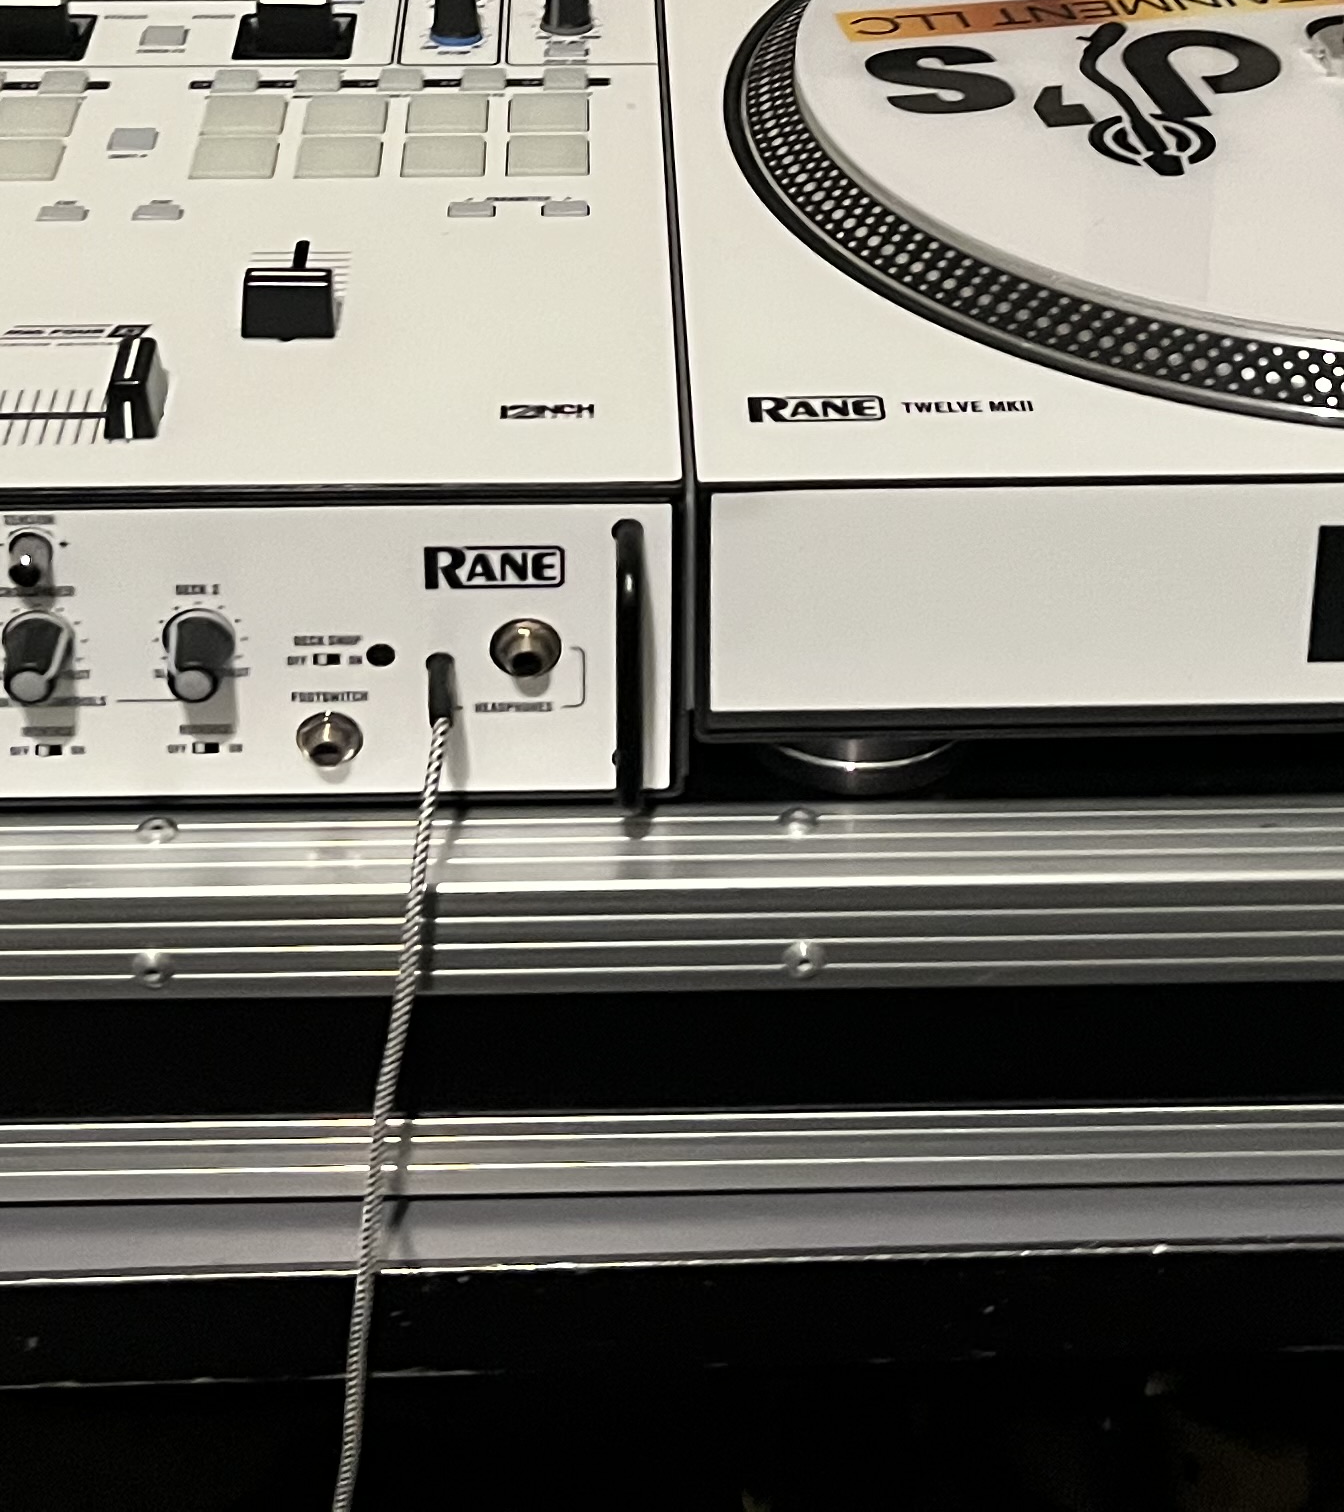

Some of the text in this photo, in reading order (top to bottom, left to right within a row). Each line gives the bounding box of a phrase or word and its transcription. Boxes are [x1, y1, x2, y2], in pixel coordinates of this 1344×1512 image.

[849, 12, 970, 36] LLC
[747, 395, 1035, 423] RANE TWELVE MKII
[424, 546, 566, 590] RANE
